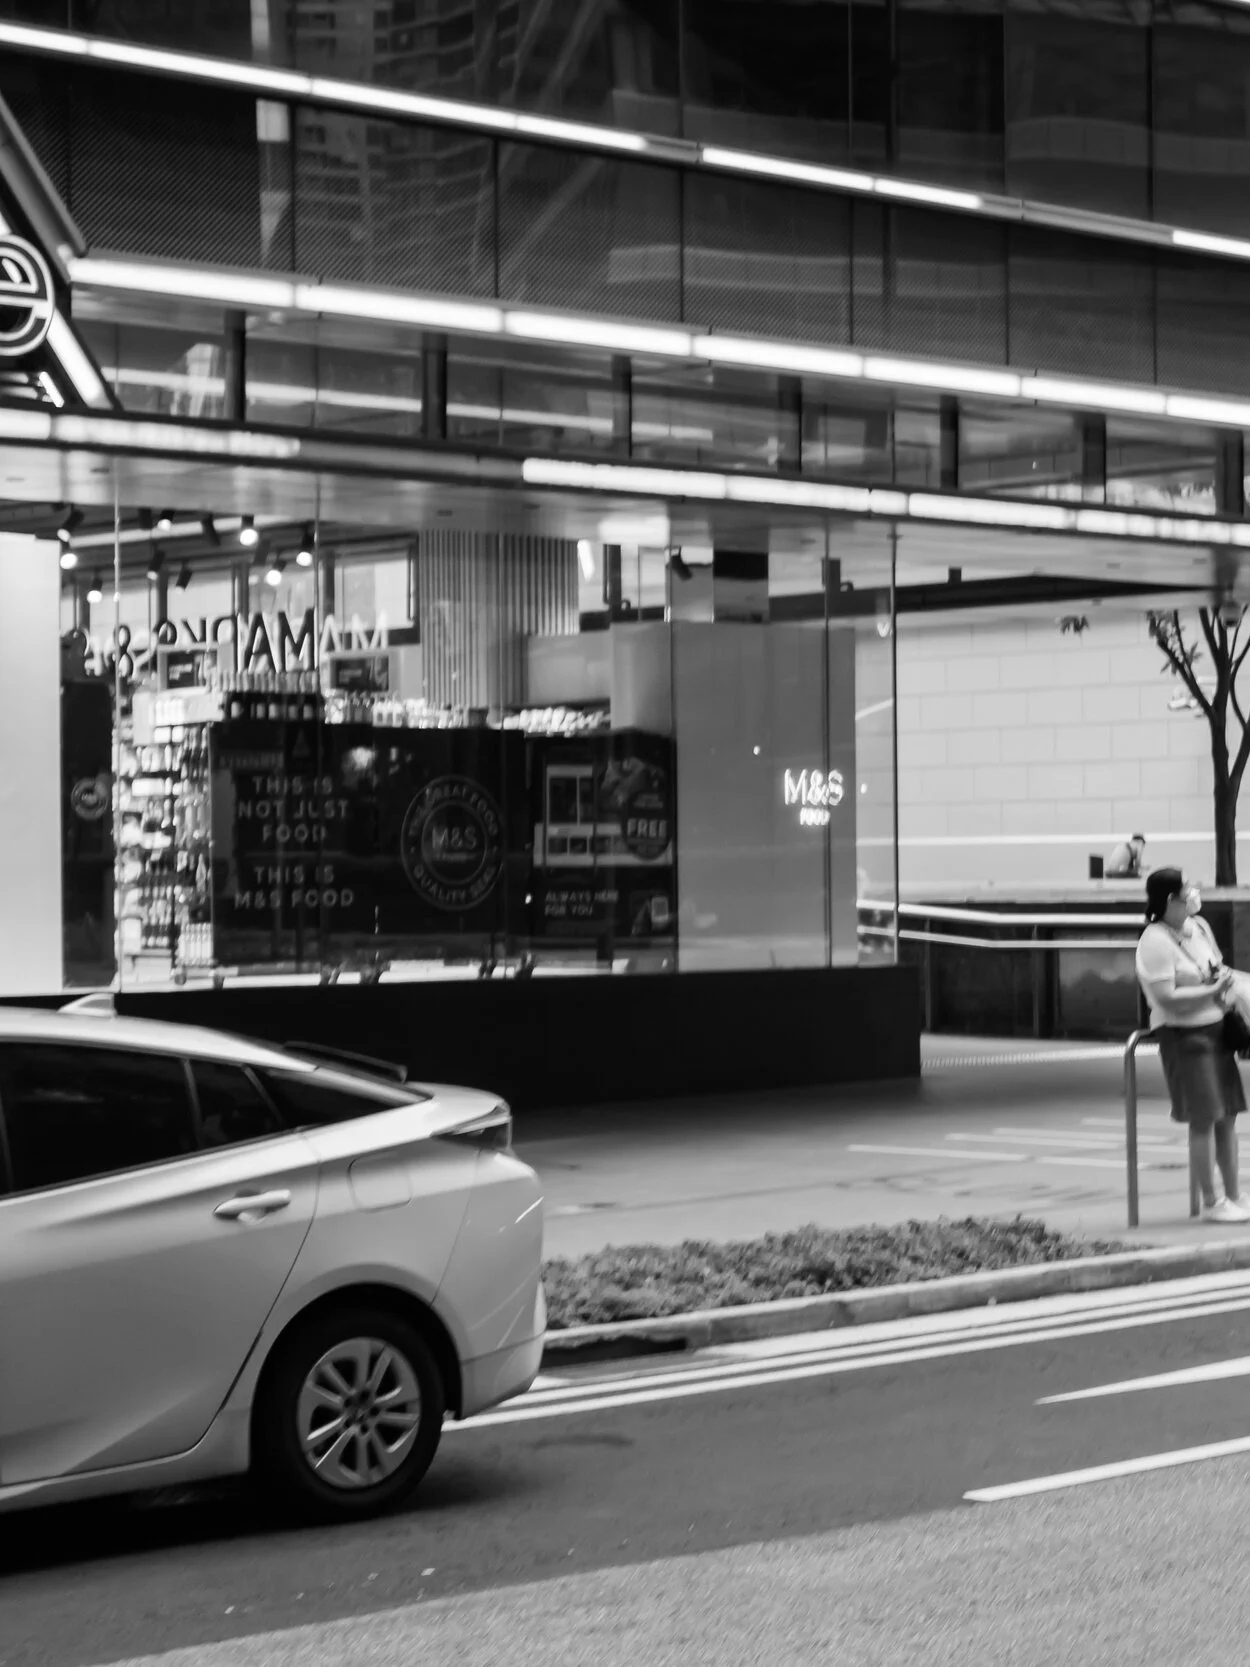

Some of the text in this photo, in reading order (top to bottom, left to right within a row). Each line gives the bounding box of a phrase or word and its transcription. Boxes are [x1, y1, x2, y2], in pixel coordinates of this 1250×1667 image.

[253, 775, 333, 795] THIS IS
[784, 768, 844, 806] M&S
[237, 799, 349, 819] NOT JUST
[262, 823, 328, 843] FOOD
[627, 818, 667, 837] FREE
[432, 826, 478, 850] M&S
[253, 864, 334, 885] THIS IS
[234, 888, 355, 910] M&S FOOD
